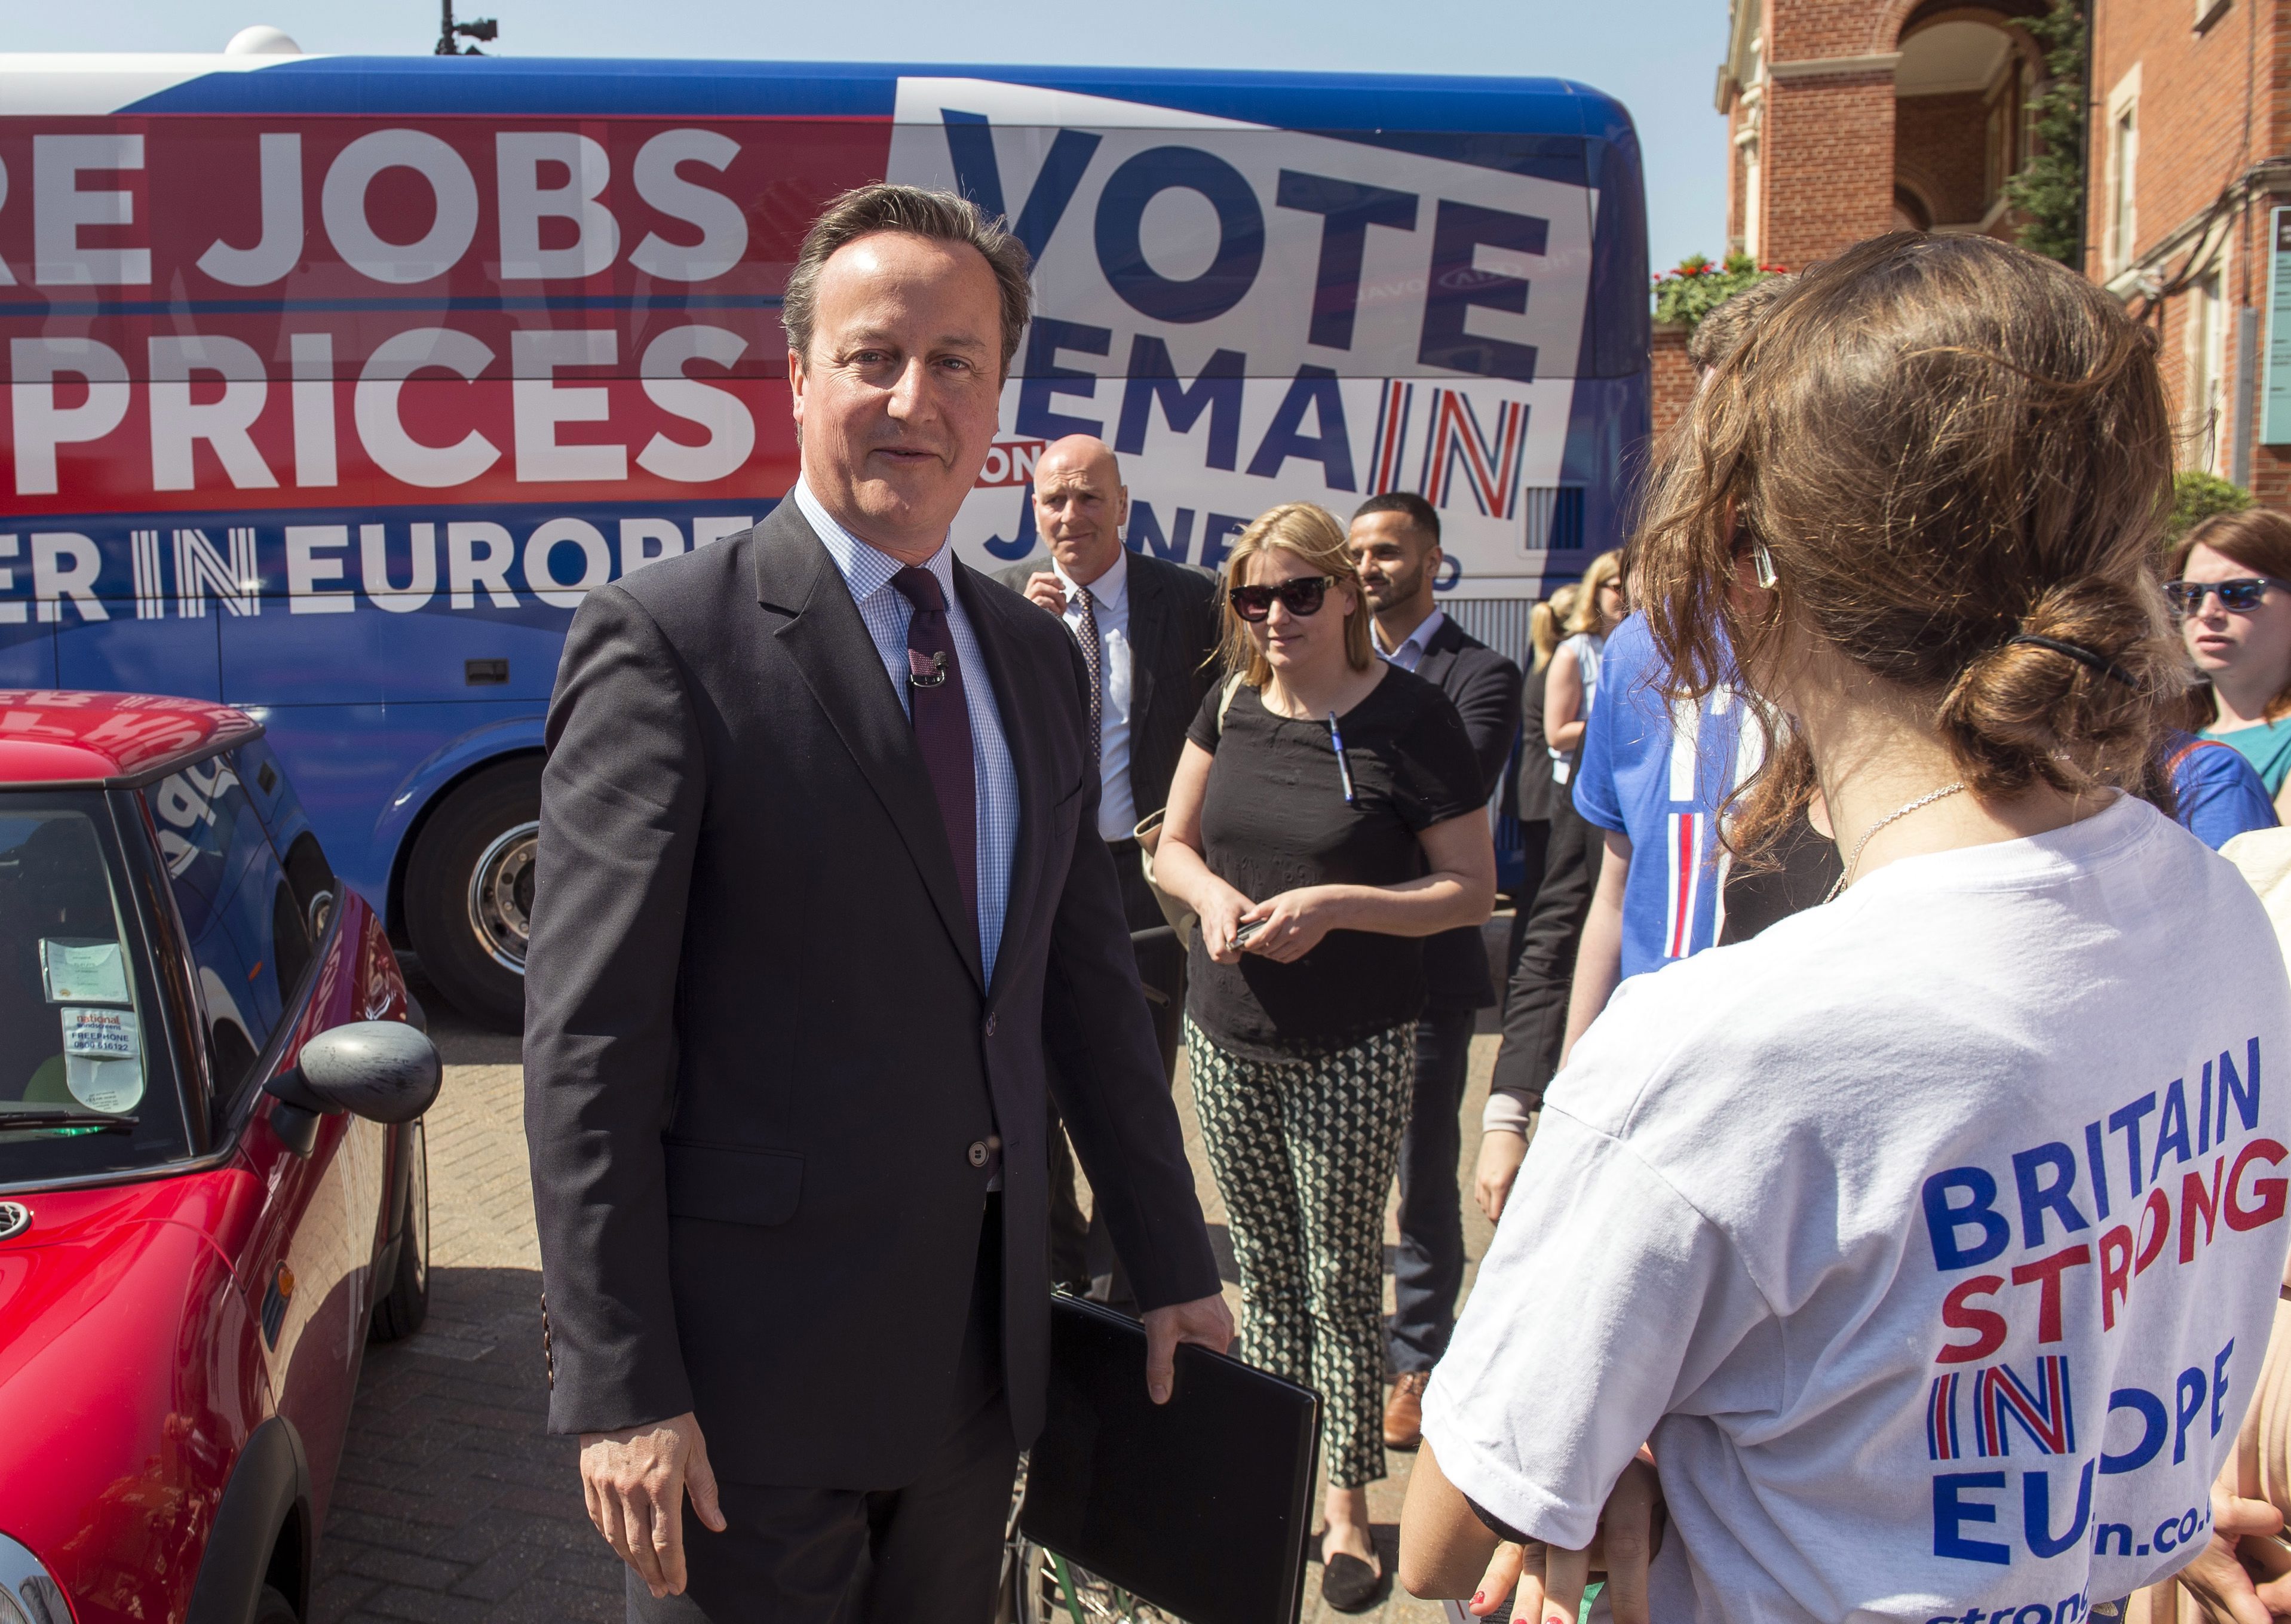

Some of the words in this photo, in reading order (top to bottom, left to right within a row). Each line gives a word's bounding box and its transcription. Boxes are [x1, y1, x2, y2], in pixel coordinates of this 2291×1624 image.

[0, 133, 152, 286] E
[195, 127, 748, 287] JOBS
[940, 108, 1550, 383] VOTE
[10, 324, 756, 496] PRICES
[979, 445, 1042, 484] ON
[998, 314, 1531, 521] EMAIN
[130, 526, 261, 621] IN
[983, 481, 1255, 571] JNE
[72, 1032, 130, 1042] FREEPHONE
[76, 1014, 121, 1025] national
[1921, 1036, 2261, 1272] BRITAIN
[1925, 1353, 2076, 1462] IN
[1932, 1336, 2236, 1566] EUOPE
